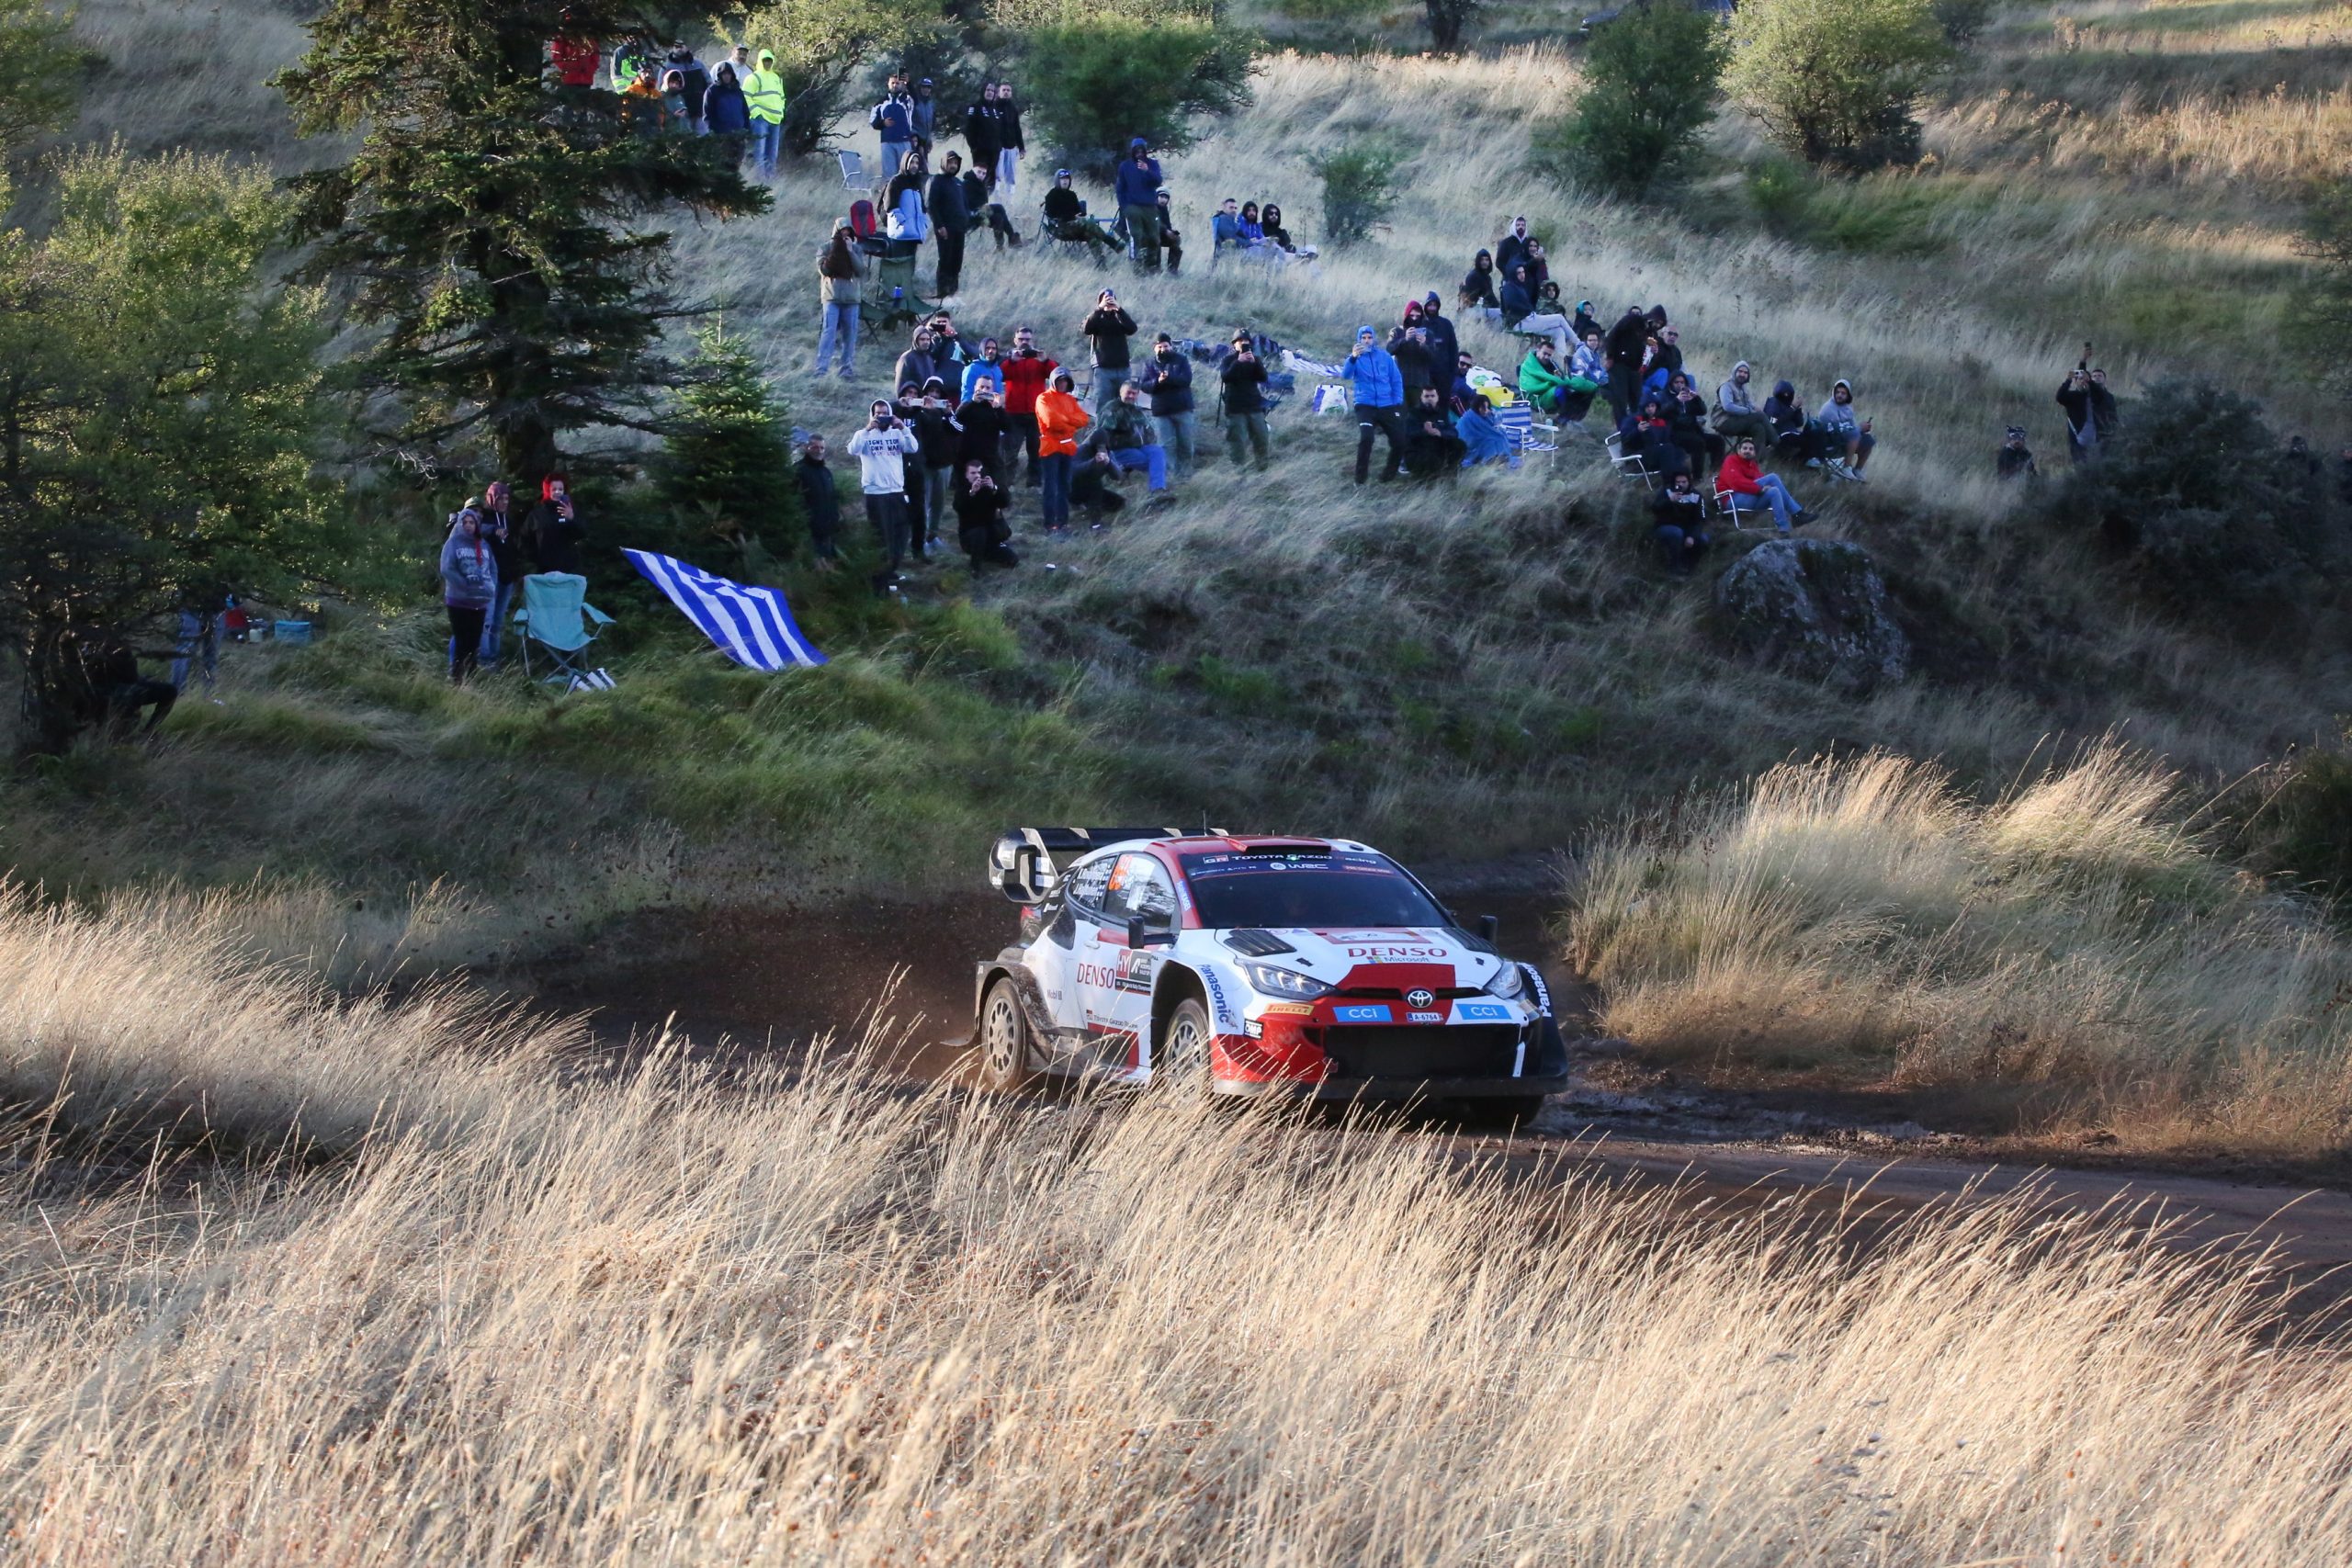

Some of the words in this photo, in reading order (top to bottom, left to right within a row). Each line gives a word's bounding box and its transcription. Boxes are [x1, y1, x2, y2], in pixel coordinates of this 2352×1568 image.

[1348, 947, 1448, 958] DENSO
[1076, 963, 1115, 989] DENSO
[1197, 964, 1231, 1023] Panasonic
[1244, 1023, 1263, 1036] OMP
